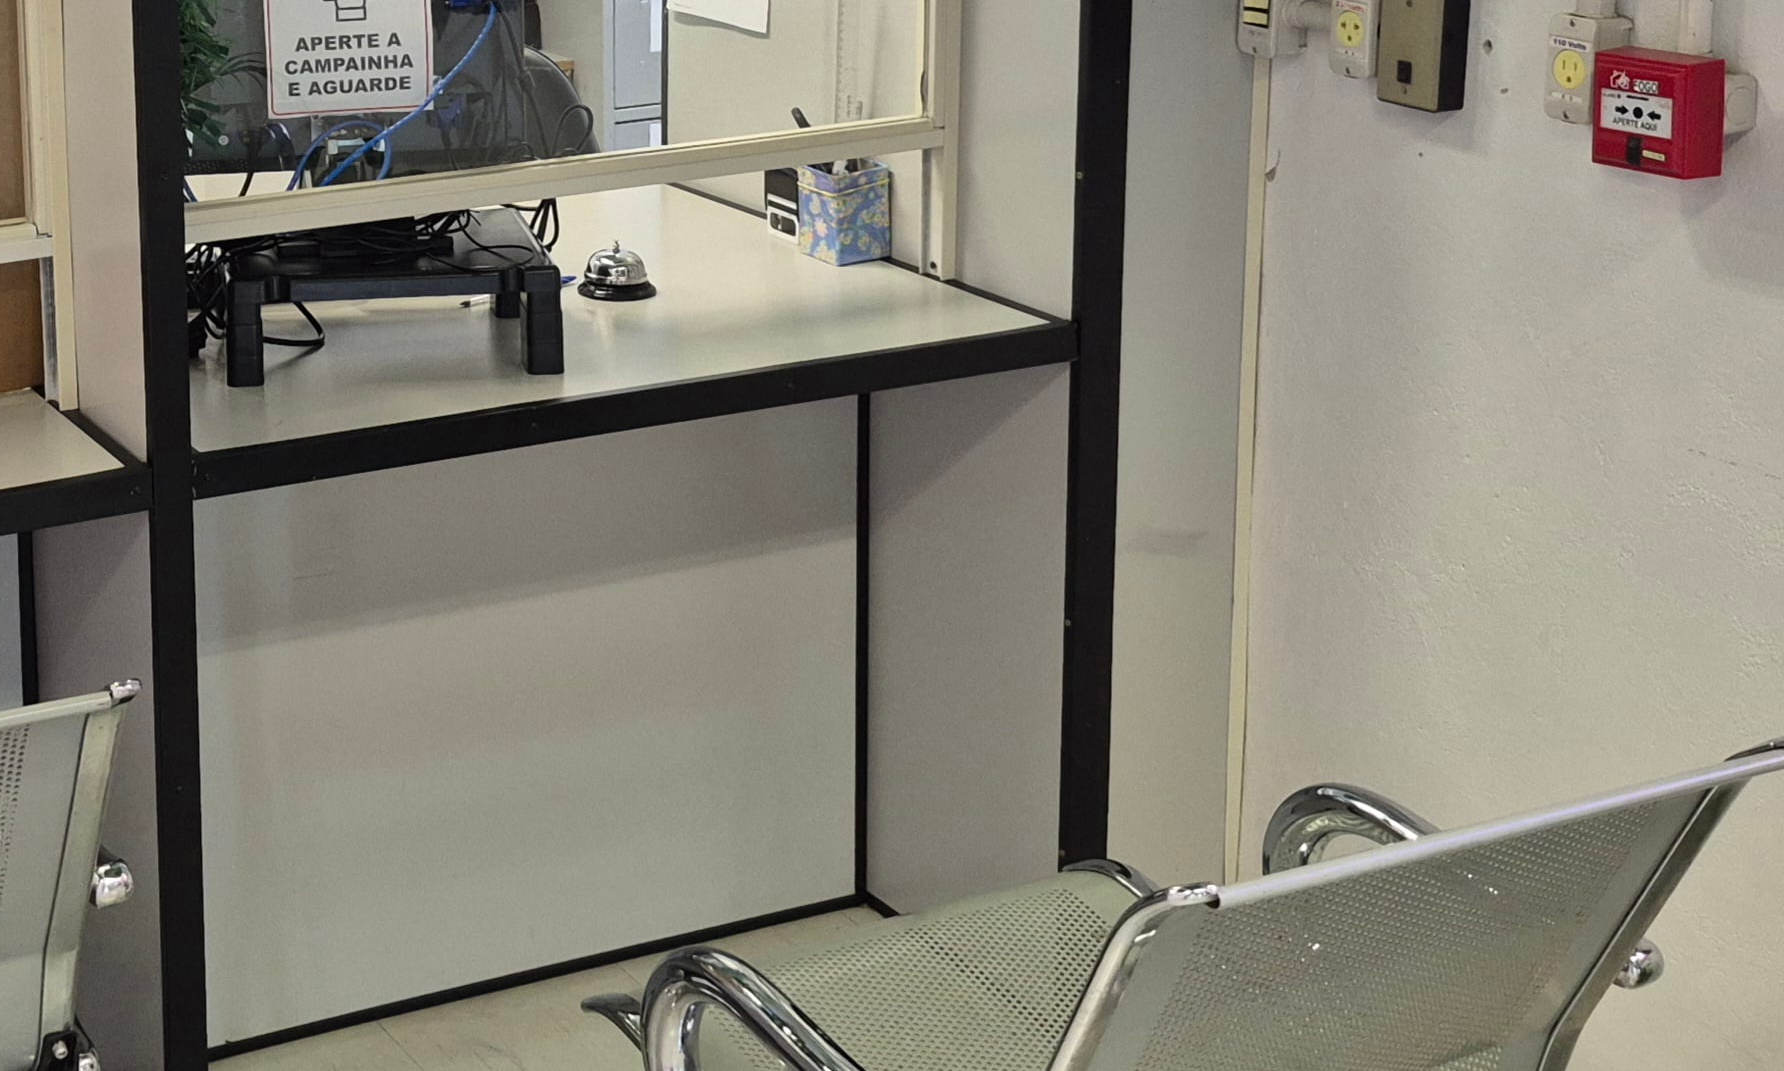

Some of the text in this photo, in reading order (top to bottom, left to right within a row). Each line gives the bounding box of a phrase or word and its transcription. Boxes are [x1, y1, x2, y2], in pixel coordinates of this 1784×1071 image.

[295, 32, 402, 52] APERTE A
[284, 53, 414, 76] CAMPAINHA
[288, 75, 412, 97] E AGUARDE
[1612, 116, 1639, 129] APERTE
